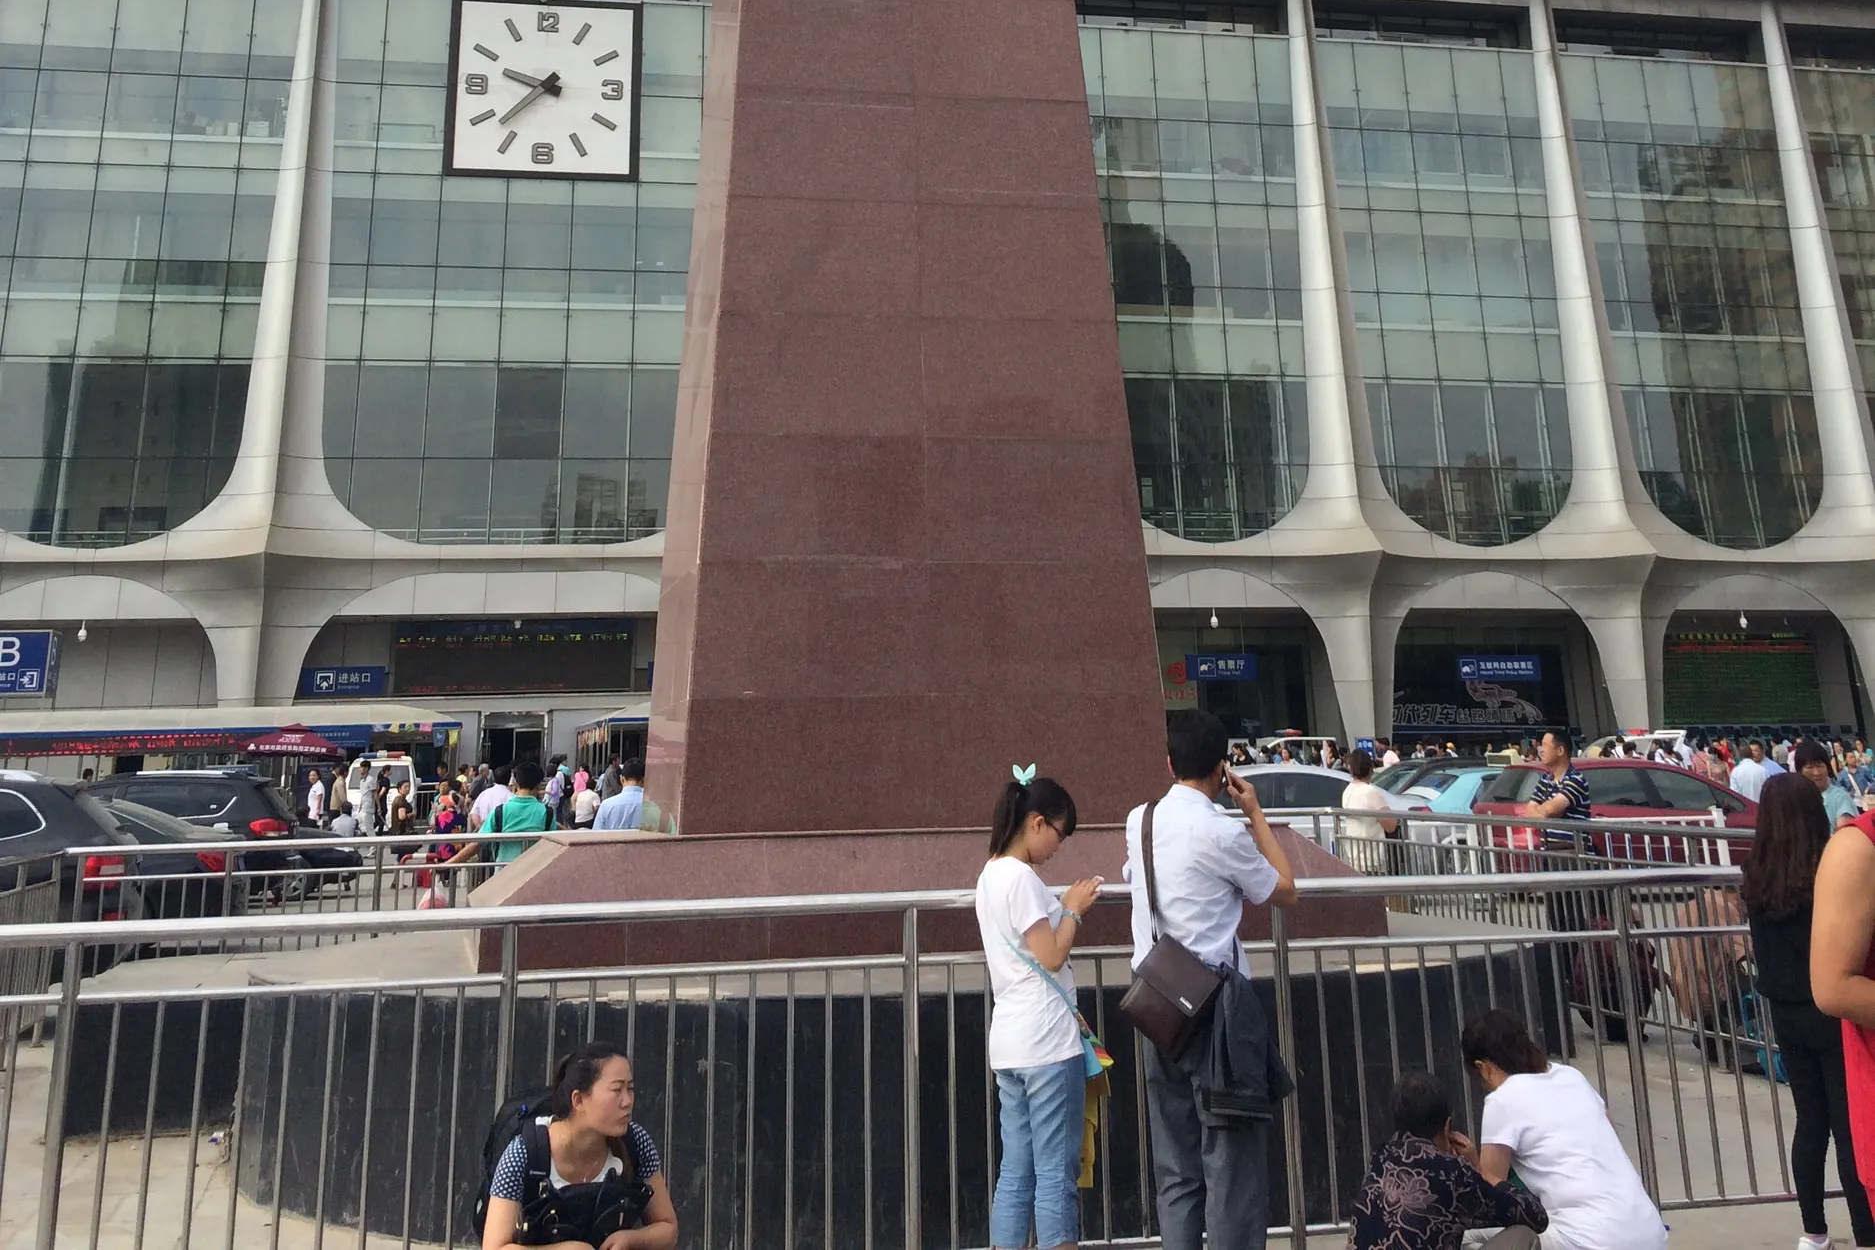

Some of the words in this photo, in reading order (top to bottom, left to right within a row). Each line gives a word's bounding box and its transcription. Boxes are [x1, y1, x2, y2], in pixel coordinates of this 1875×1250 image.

[537, 11, 560, 33] 12
[465, 73, 488, 95] 9
[601, 79, 624, 101] 3
[531, 142, 554, 165] 6
[0, 636, 20, 667] B
[1217, 659, 1245, 670] 售票厅
[337, 672, 371, 684] 进站口
